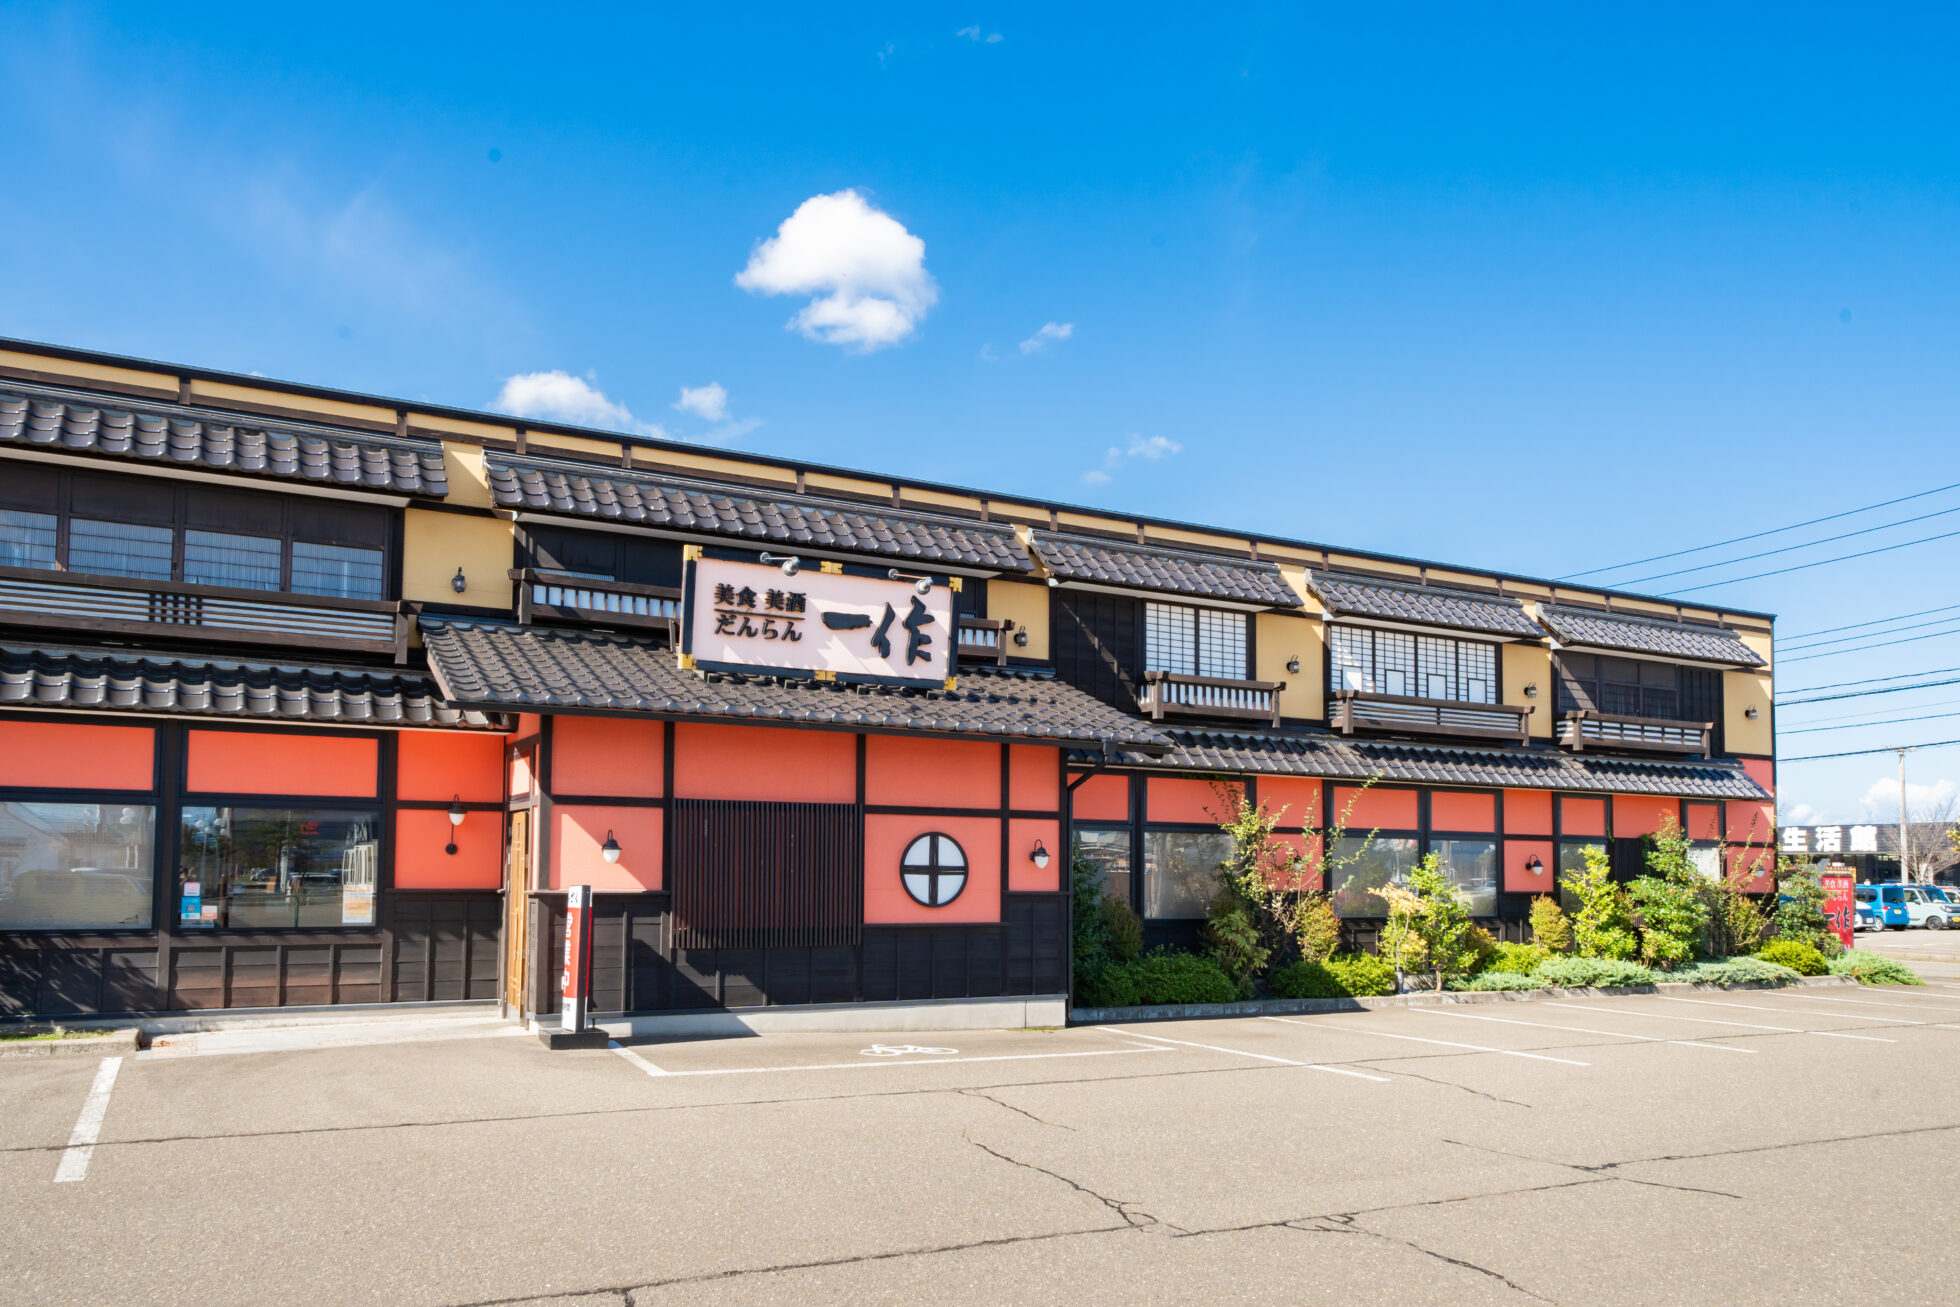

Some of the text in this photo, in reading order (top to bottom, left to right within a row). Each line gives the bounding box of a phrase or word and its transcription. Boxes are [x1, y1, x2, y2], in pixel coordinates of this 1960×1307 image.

[714, 583, 806, 613] 美食 美酒
[714, 614, 803, 642] だんらん
[821, 595, 935, 666] 一作
